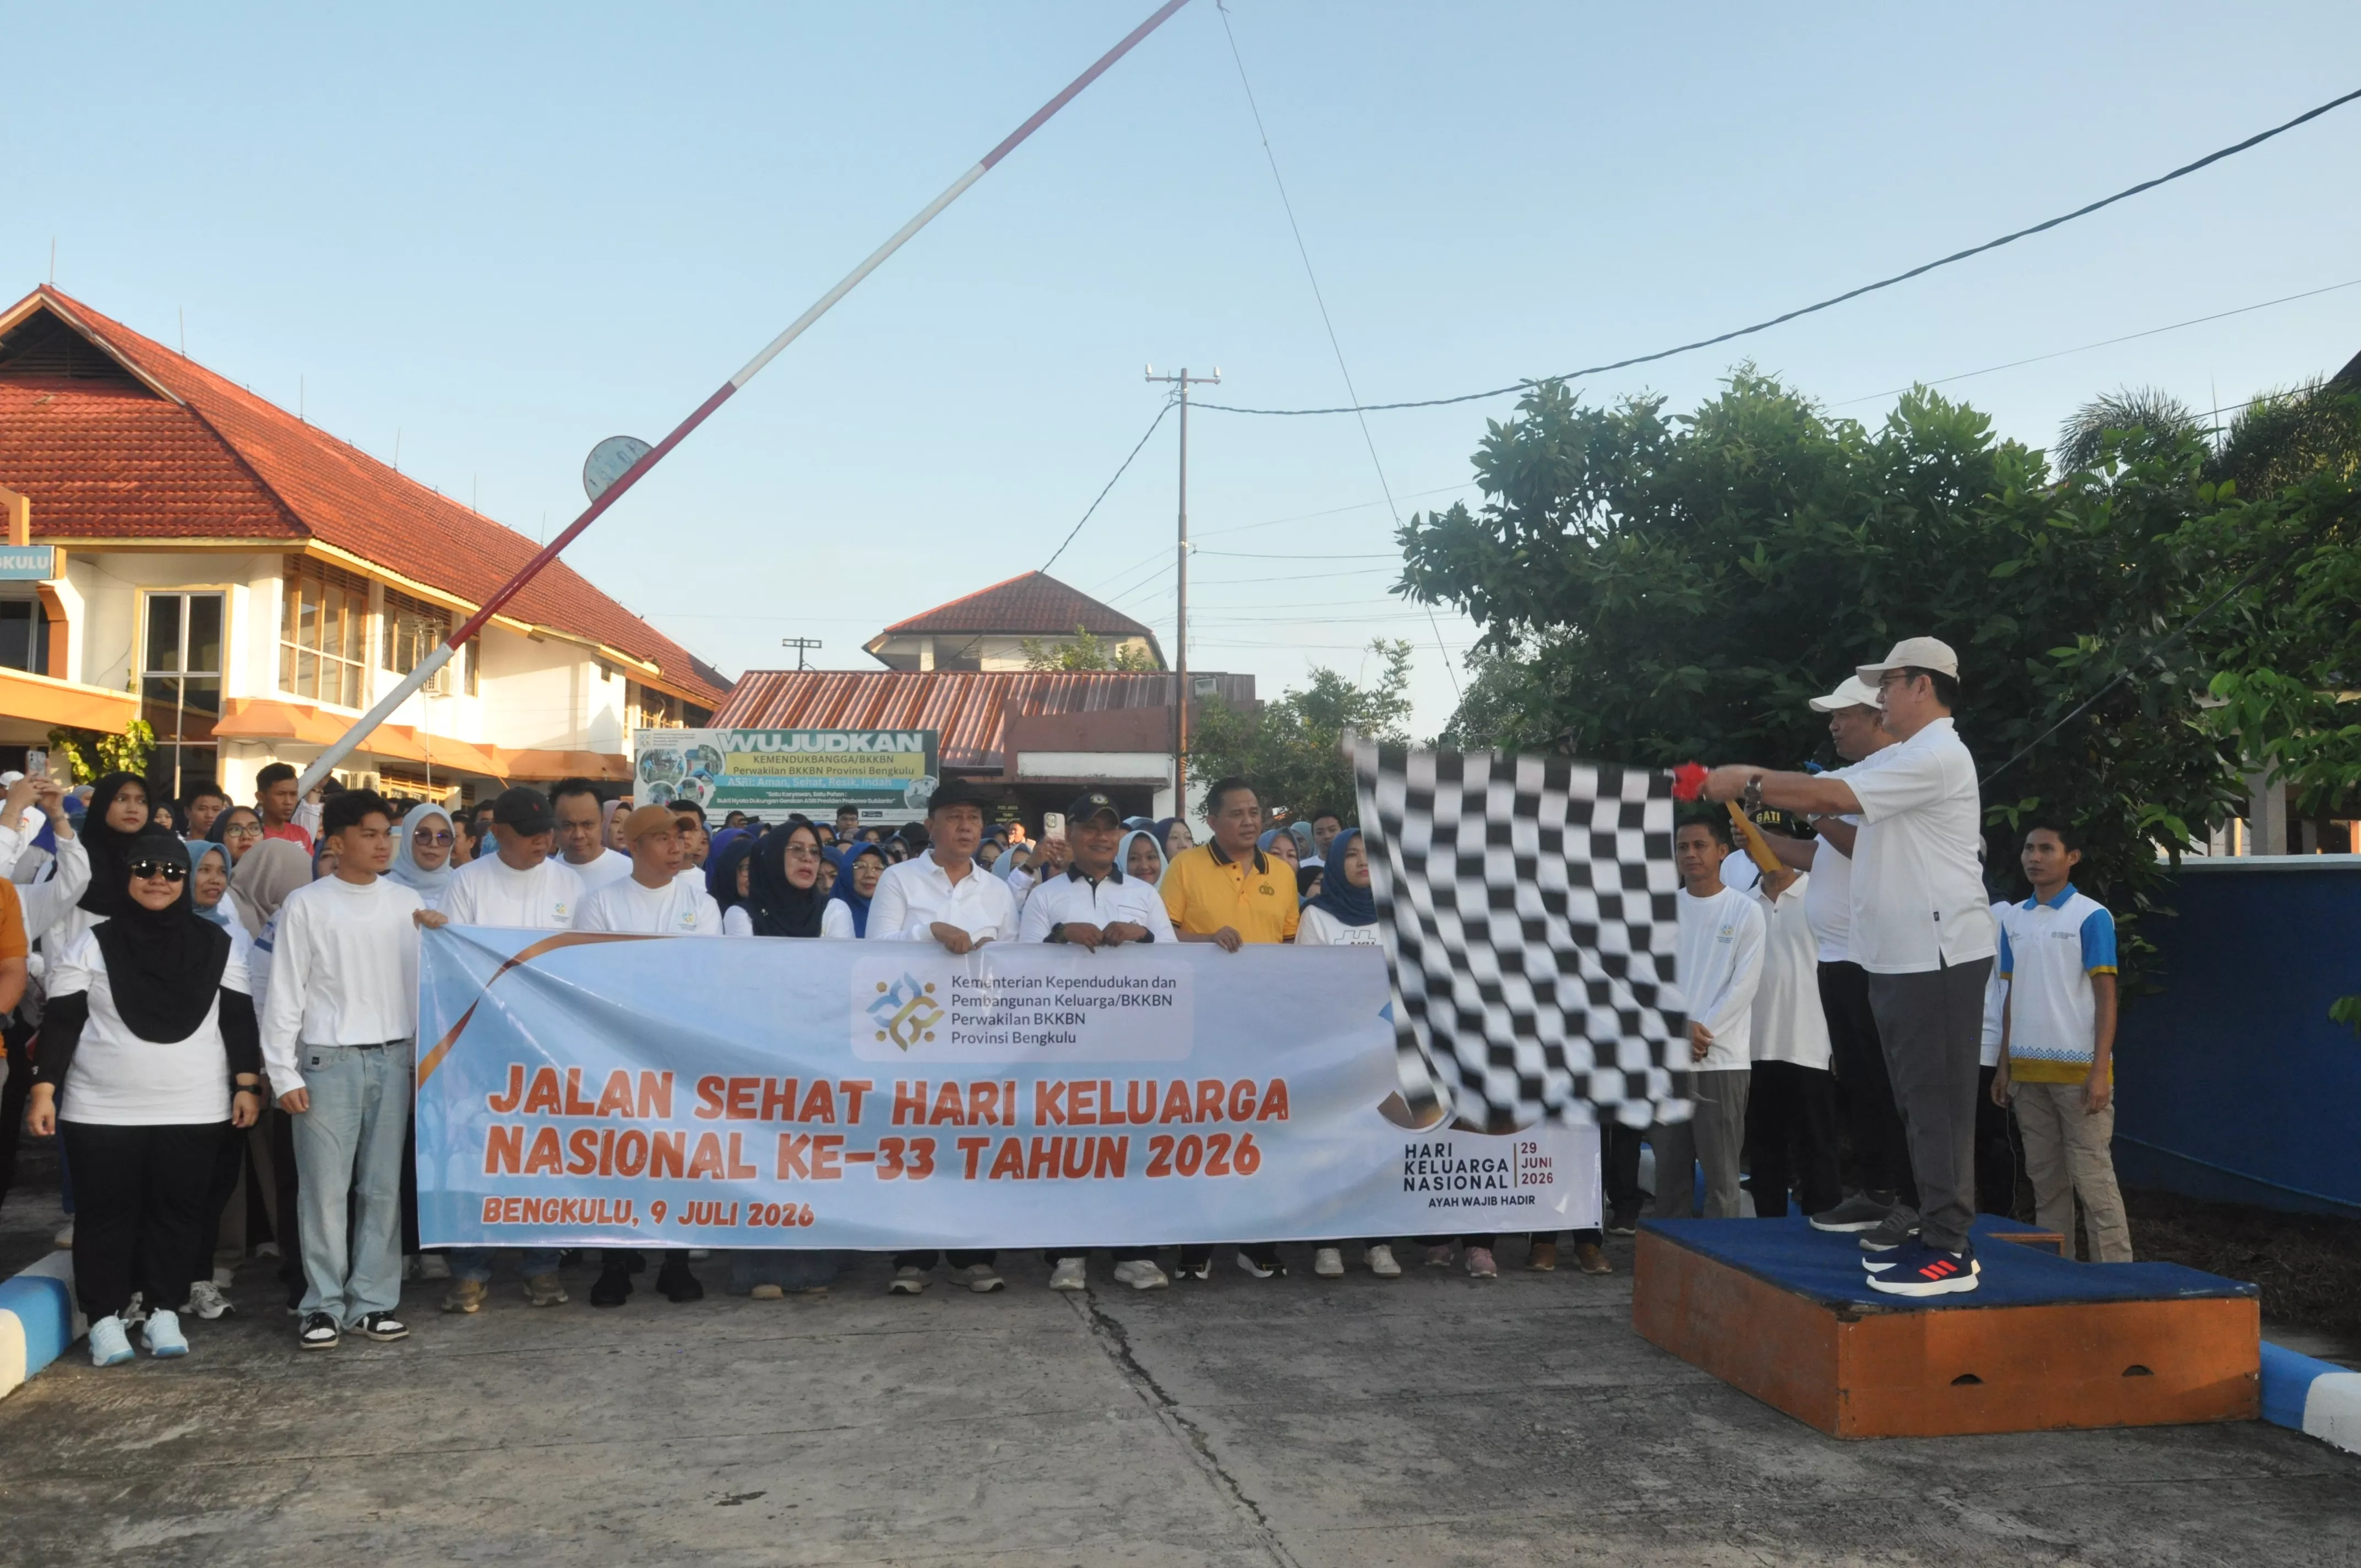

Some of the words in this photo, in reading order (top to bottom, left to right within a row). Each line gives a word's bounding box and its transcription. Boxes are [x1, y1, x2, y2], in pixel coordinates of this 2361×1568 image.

[0, 556, 49, 569] KULU
[717, 733, 923, 753] WUJUDKAN
[753, 755, 894, 764] KEMENDUKBANGGA/BKKBN
[733, 766, 786, 775] Perwakilan
[789, 767, 824, 775] BKKBN
[826, 767, 866, 776] Provinsi
[869, 767, 915, 777] Bengkulu
[728, 778, 754, 786] ASRI:
[758, 778, 789, 788] Aman,
[793, 778, 826, 788] Sehat,
[829, 778, 859, 788] Resik,
[862, 778, 891, 787] Indah
[1756, 810, 1780, 823] GATI
[951, 976, 1042, 989] Kementerian
[1046, 976, 1150, 991] Kependudukan
[1152, 976, 1177, 989] dan
[951, 994, 1051, 1009] Pembangunan
[1055, 994, 1172, 1009] Keluarga/BKKBN
[951, 1012, 1030, 1026] Perwakilan
[1035, 1013, 1085, 1025] BKKBN
[951, 1031, 1009, 1044] Provinsi
[1013, 1031, 1076, 1047] Bengkulu
[488, 1065, 673, 1118] JALAN
[694, 1076, 873, 1125] SEHAT
[891, 1081, 1015, 1126] HARI
[1035, 1079, 1289, 1125] KELUARGA
[485, 1126, 757, 1179] NASIONAL
[777, 1133, 935, 1181] KE-33
[957, 1136, 1129, 1180] TAHUN
[1146, 1131, 1261, 1178] 2026
[1405, 1142, 1452, 1159] HARI
[1521, 1142, 1537, 1154] 29
[1404, 1158, 1509, 1175] KELUARGA
[1521, 1157, 1552, 1169] JUNI
[1403, 1174, 1508, 1192] NASIONAL
[1521, 1172, 1553, 1185] 2026
[1428, 1196, 1459, 1208] AYAH
[1462, 1196, 1498, 1207] WAJIB
[1500, 1195, 1536, 1206] HADIR
[482, 1197, 640, 1227] BENGKULU,
[650, 1200, 667, 1225] 9
[678, 1202, 738, 1226] JULI
[747, 1203, 814, 1227] 2026
